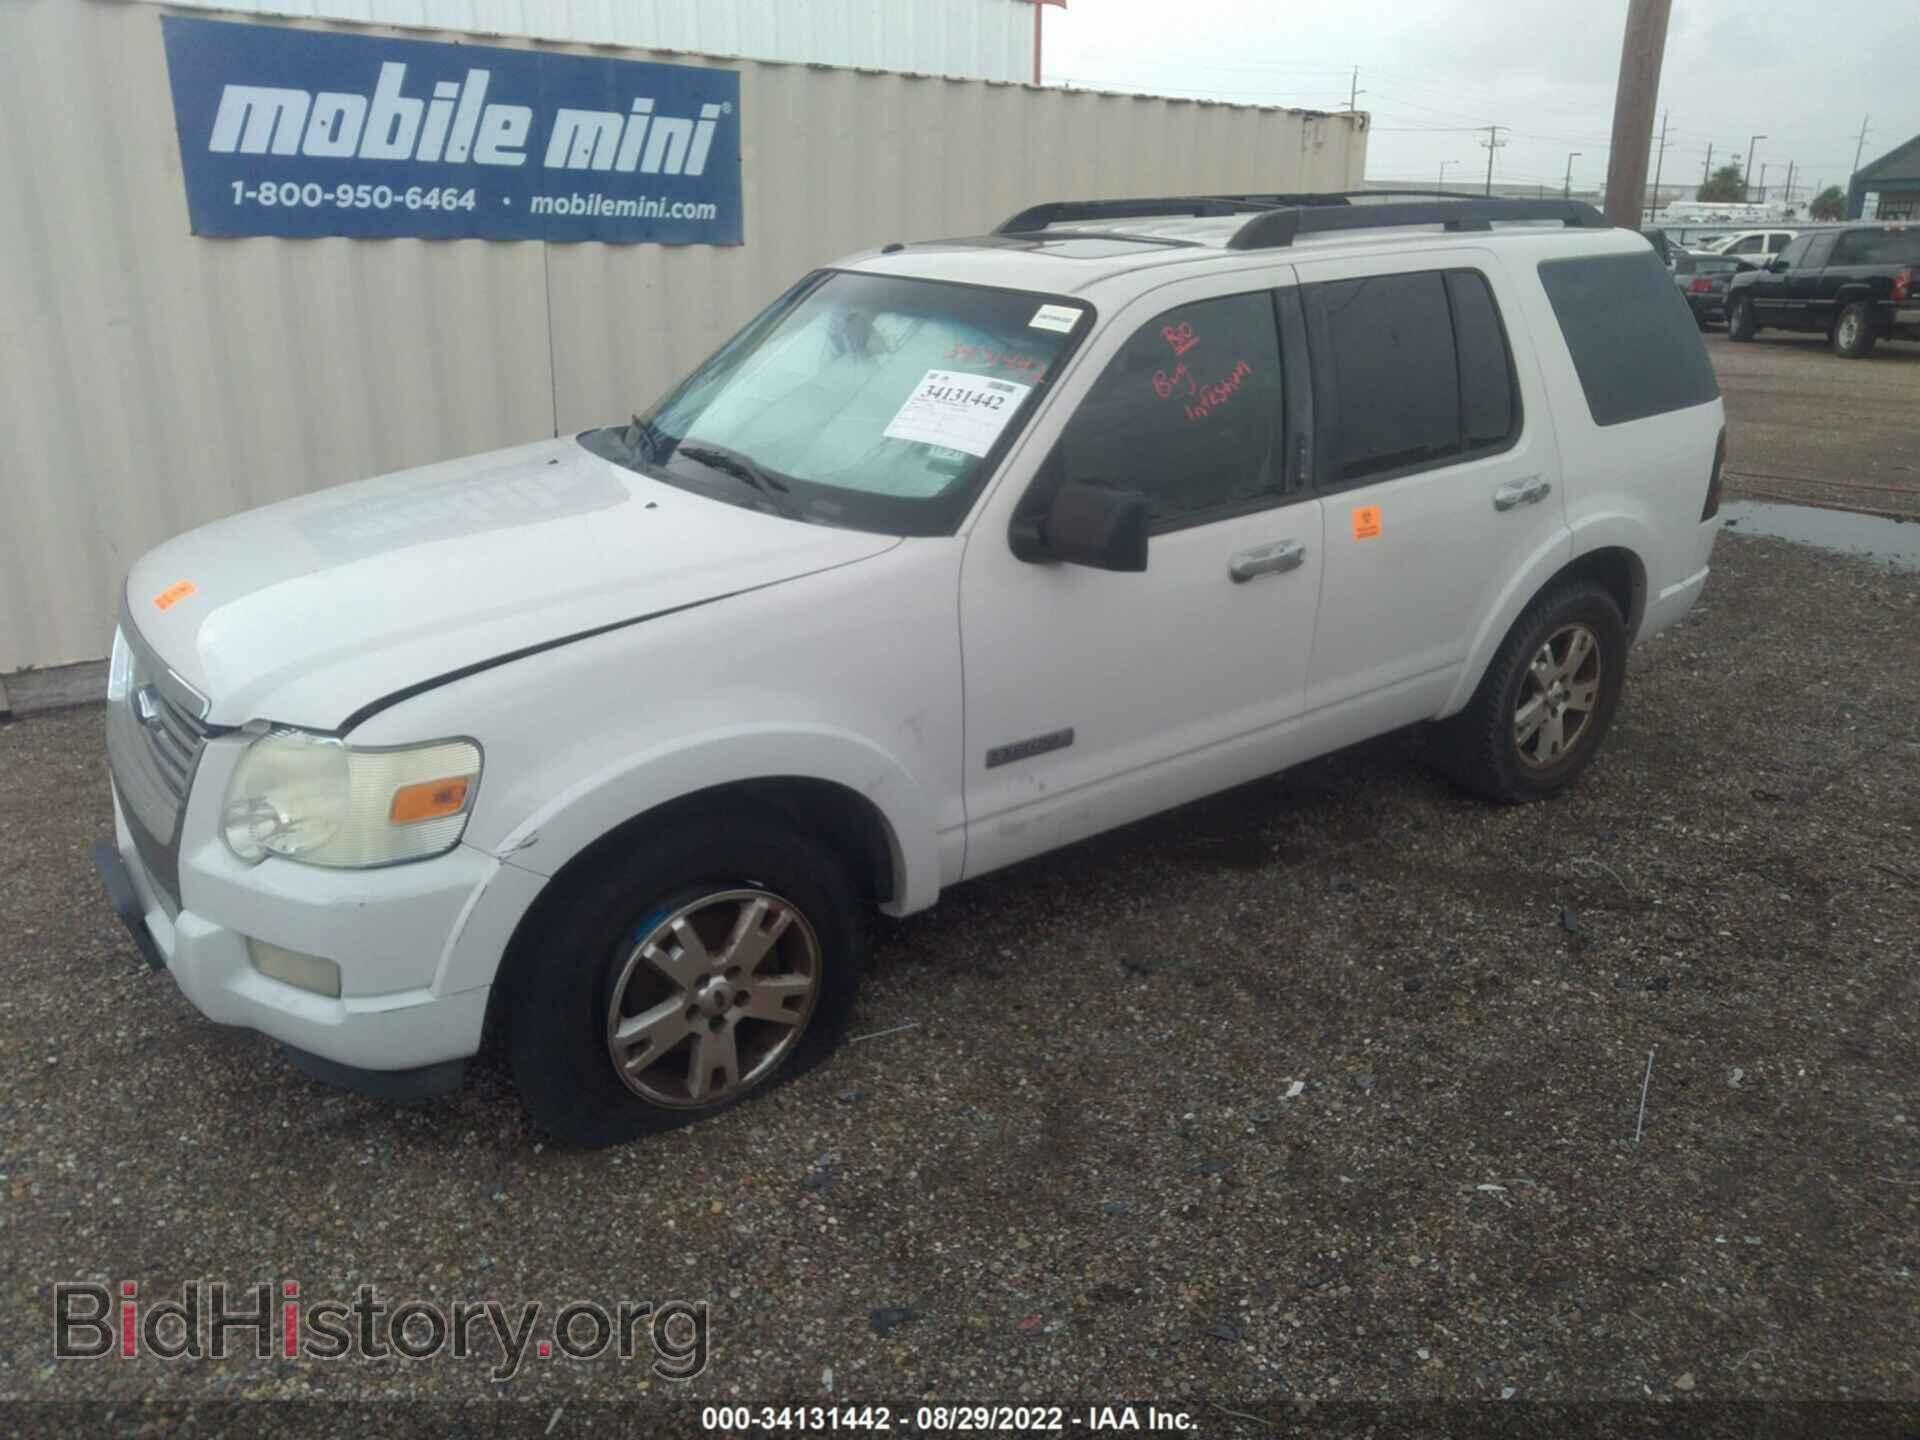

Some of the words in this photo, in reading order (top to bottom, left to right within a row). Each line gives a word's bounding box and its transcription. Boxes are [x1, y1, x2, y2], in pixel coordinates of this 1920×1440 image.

[208, 61, 533, 166] mobile
[231, 180, 476, 211] 1-800-950-6464
[530, 192, 717, 220] mobilemini.com
[920, 384, 1006, 411] 34131442
